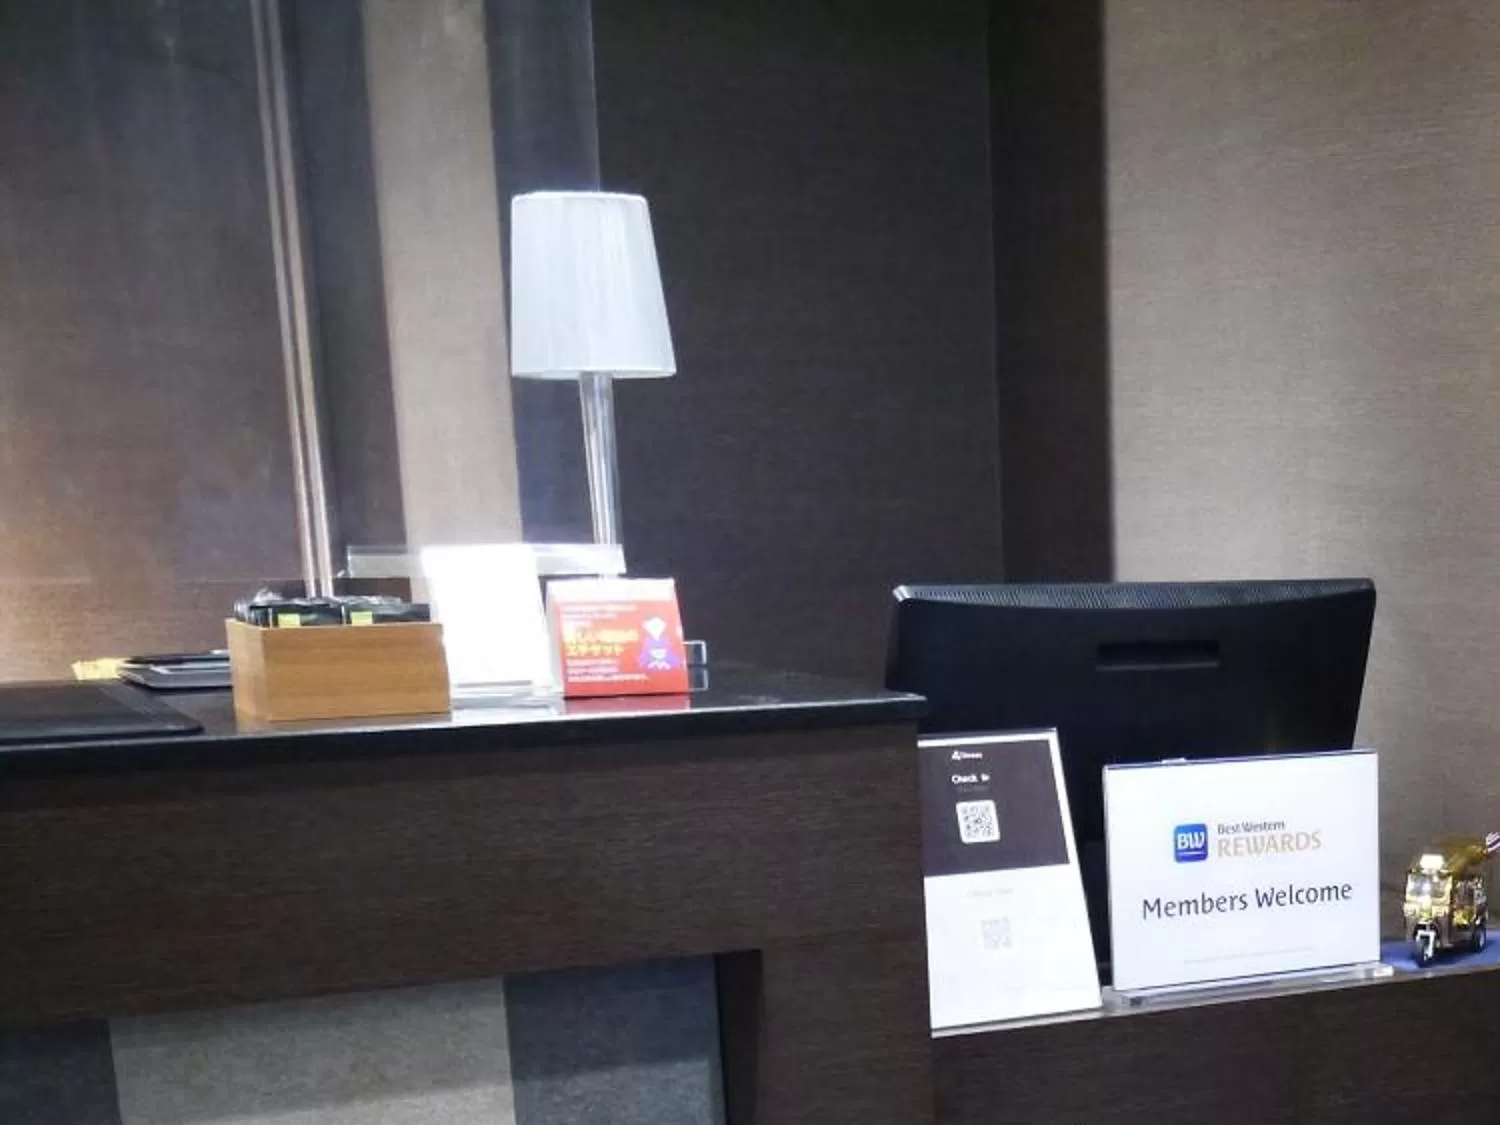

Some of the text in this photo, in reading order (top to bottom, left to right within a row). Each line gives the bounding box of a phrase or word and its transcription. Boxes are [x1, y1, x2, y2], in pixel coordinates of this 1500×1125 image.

[1217, 820, 1286, 835] Best Western
[1177, 832, 1206, 850] BW
[1217, 830, 1322, 858] REWARDS
[1142, 882, 1353, 920] Members Welcome
